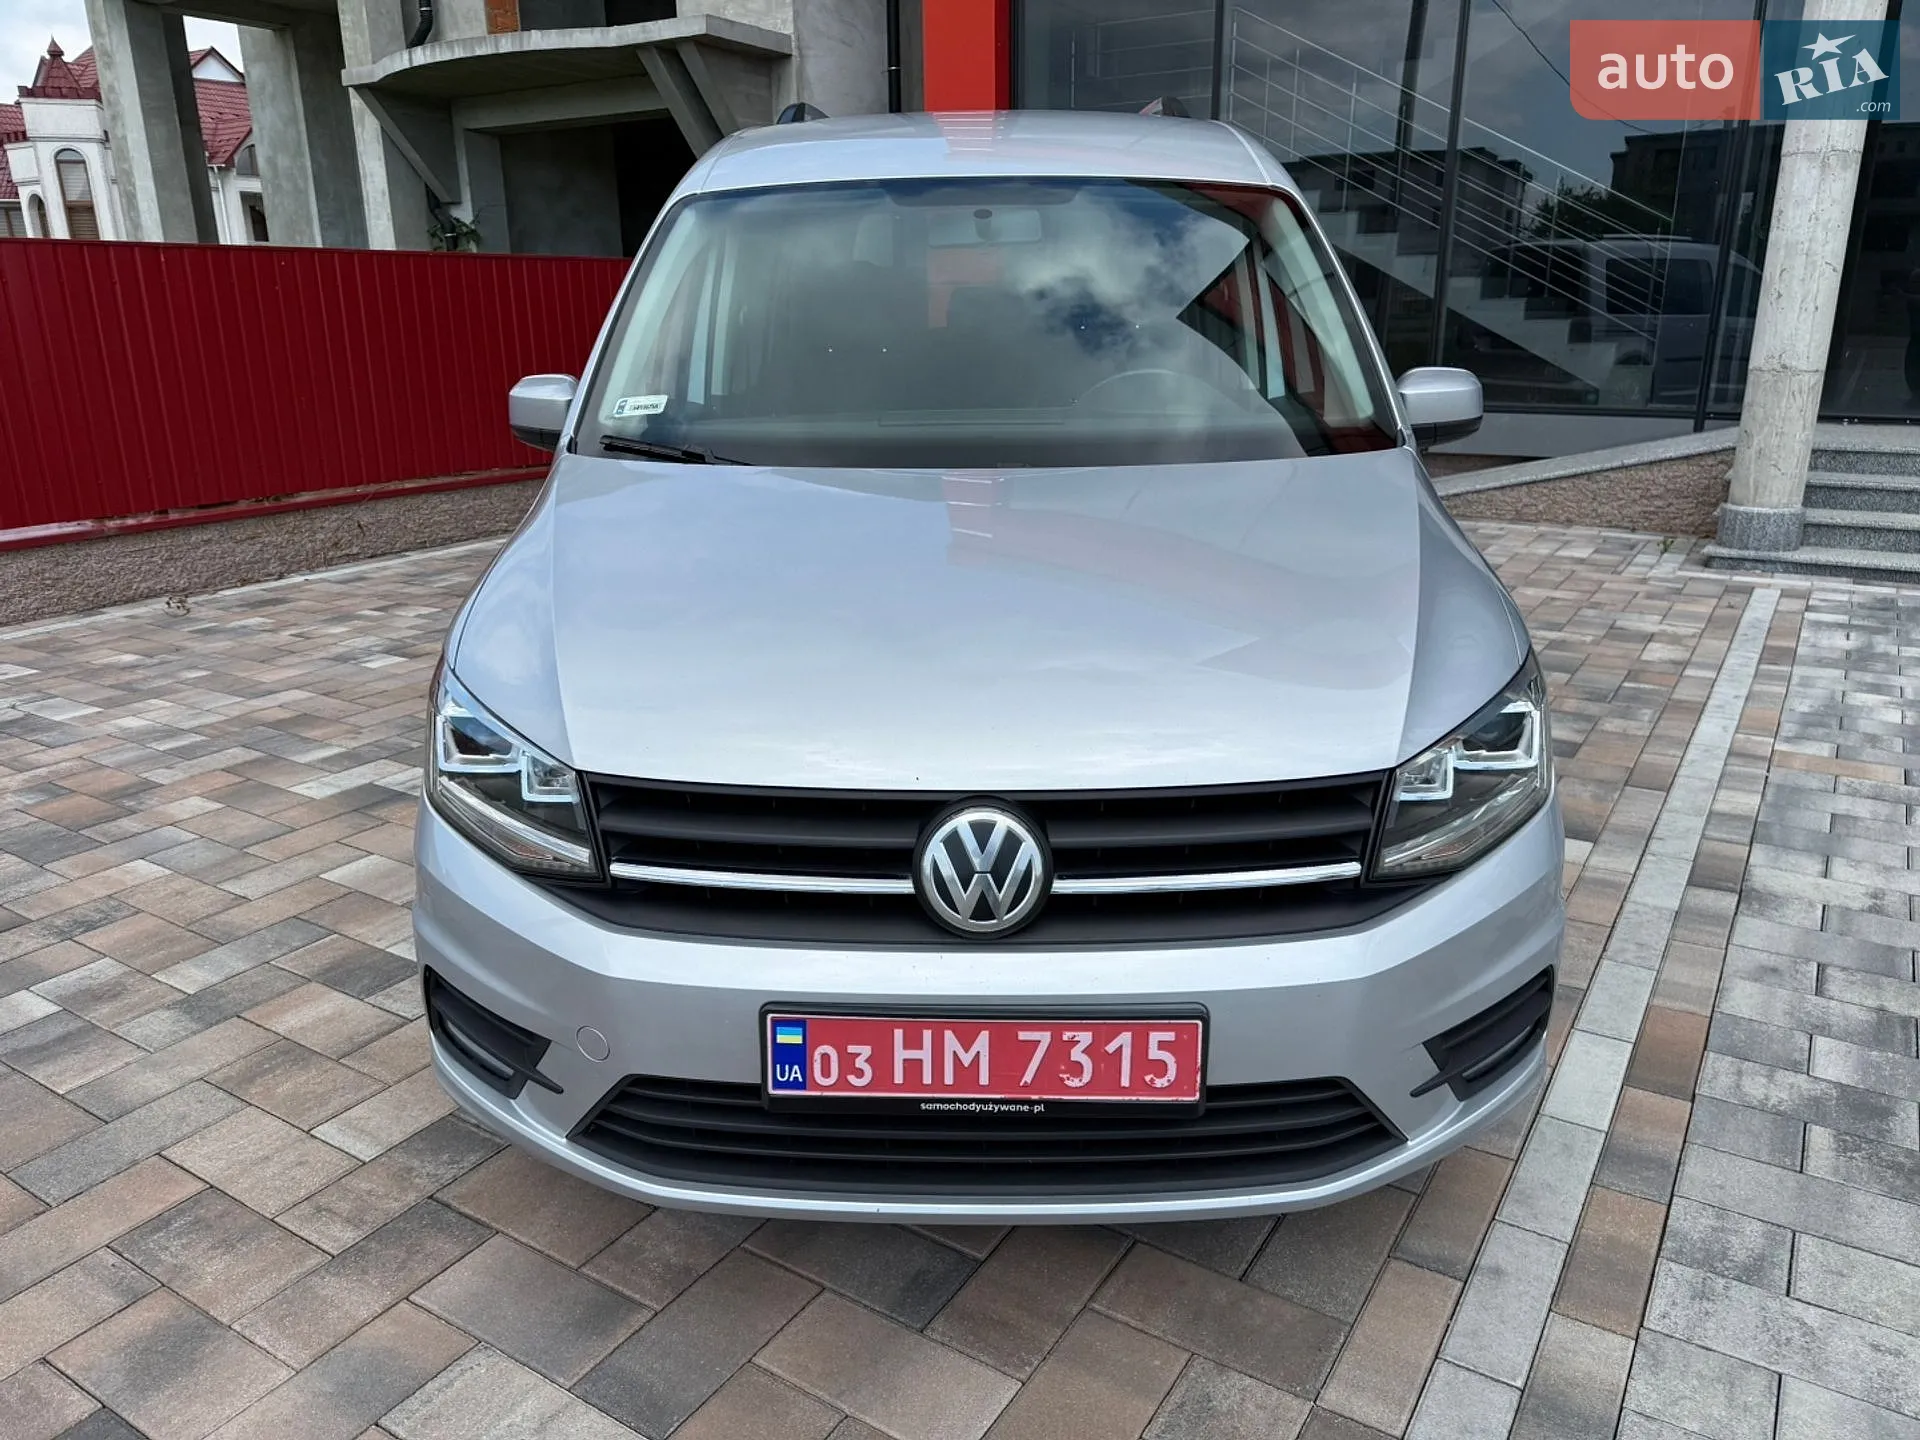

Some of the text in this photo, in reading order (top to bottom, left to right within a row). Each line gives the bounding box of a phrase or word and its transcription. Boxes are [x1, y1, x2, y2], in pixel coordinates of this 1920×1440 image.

[776, 1064, 803, 1082] UA
[813, 1028, 1177, 1088] 03 HM 7315
